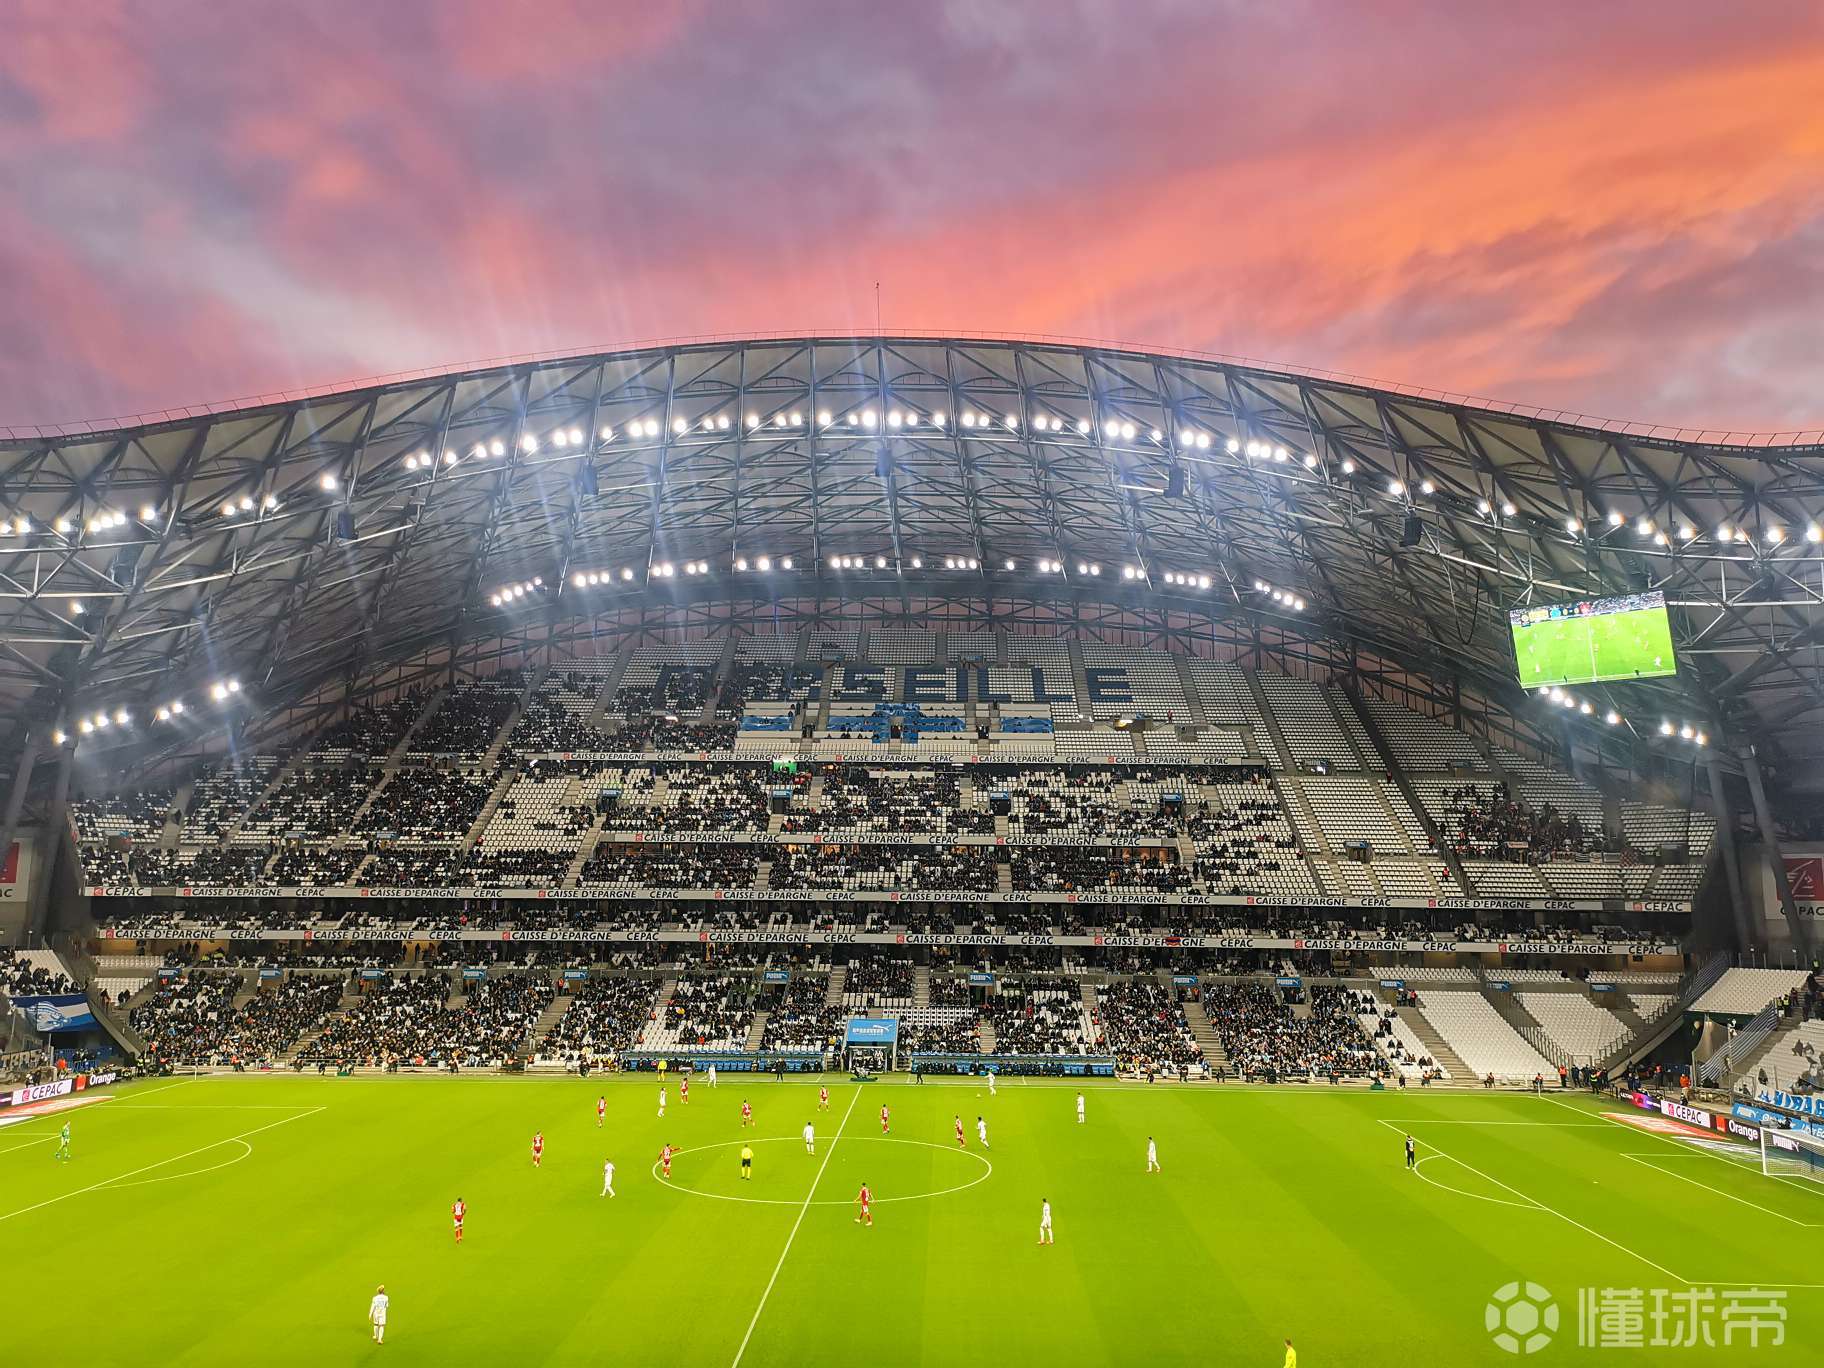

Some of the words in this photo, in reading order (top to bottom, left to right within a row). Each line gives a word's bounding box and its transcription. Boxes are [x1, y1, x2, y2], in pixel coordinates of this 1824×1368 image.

[571, 753, 597, 761] CAISSE
[657, 753, 681, 761] CEPAC
[706, 753, 732, 761] CAISSE
[794, 754, 818, 762] CEPAC
[929, 755, 953, 763] CEPAC
[979, 755, 1005, 763] CAISSE
[1065, 756, 1089, 764] CEPAC
[1115, 756, 1141, 764] CAISSE
[1204, 757, 1228, 765] CEPAC
[644, 833, 677, 842] CAISSE
[680, 834, 735, 842] D'EPARGNE
[750, 834, 779, 843] CEPAC
[822, 835, 854, 843] CAISSE
[857, 835, 913, 844] D'EPARGNE
[928, 836, 958, 844] CEPAC
[1005, 837, 1037, 845] CAISSE
[1040, 837, 1096, 846] D'EPARGNE
[1110, 838, 1140, 847] CEPAC
[105, 887, 144, 897] CEPAC
[192, 888, 223, 897] CAISSE
[226, 888, 282, 897] D'EPARGNE
[295, 888, 325, 897] CEPAC
[370, 888, 402, 897] CAISSE
[405, 888, 460, 898] D'EPARGNE
[473, 889, 503, 898] CEPAC
[547, 890, 580, 899] CAISSE
[582, 890, 637, 899] D'EPARGNE
[649, 890, 679, 899] CEPAC
[724, 891, 755, 900] CAISSE
[758, 891, 813, 900] D'EPARGNE
[826, 892, 855, 901] CEPAC
[900, 893, 932, 901] CAISSE
[934, 893, 990, 902] D'EPARGNE
[1002, 893, 1032, 902] CEPAC
[1077, 894, 1109, 903] CAISSE
[1112, 895, 1167, 904] D'EPARGNE
[1181, 896, 1210, 905] CEPAC
[1255, 897, 1289, 906] CAISSE
[1291, 897, 1347, 906] D'EPARGNE
[1361, 898, 1391, 907] CEPAC
[1437, 899, 1470, 908] CAISSE
[1472, 900, 1531, 909] D'EPARGNE
[1544, 901, 1575, 910] CEPAC
[1644, 902, 1683, 912] CEPAC
[1780, 906, 1824, 916] PAC
[115, 929, 152, 939] CAISSE
[154, 929, 216, 939] D'EPARGNE
[230, 930, 263, 939] CEPAC
[313, 930, 349, 940] CAISSE
[352, 930, 414, 940] D'EPARGNE
[429, 931, 462, 940] CEPAC
[512, 931, 547, 941] CAISSE
[550, 931, 612, 941] D'EPARGNE
[626, 932, 659, 941] CEPAC
[709, 932, 744, 942] CAISSE
[747, 933, 809, 942] D'EPARGNE
[823, 934, 856, 943] CEPAC
[906, 935, 942, 944] CAISSE
[944, 935, 1006, 945] D'EPARGNE
[1021, 936, 1054, 945] CEPAC
[1104, 936, 1140, 946] CAISSE
[1142, 937, 1205, 947] D'EPGNE
[1220, 939, 1254, 948] CEPAC
[1304, 940, 1340, 949] CAISSE
[1343, 941, 1407, 950] D'EPARGNE
[1422, 942, 1456, 951] CEPAC
[1508, 943, 1545, 953] CAISSE
[1548, 944, 1613, 954] D'EPARGNE
[1628, 945, 1662, 955] CEPAC
[89, 1072, 117, 1086] Orange
[31, 1082, 64, 1100] CEPAC
[1675, 1105, 1703, 1125] CEPAC
[1728, 1119, 1759, 1141] Orange
